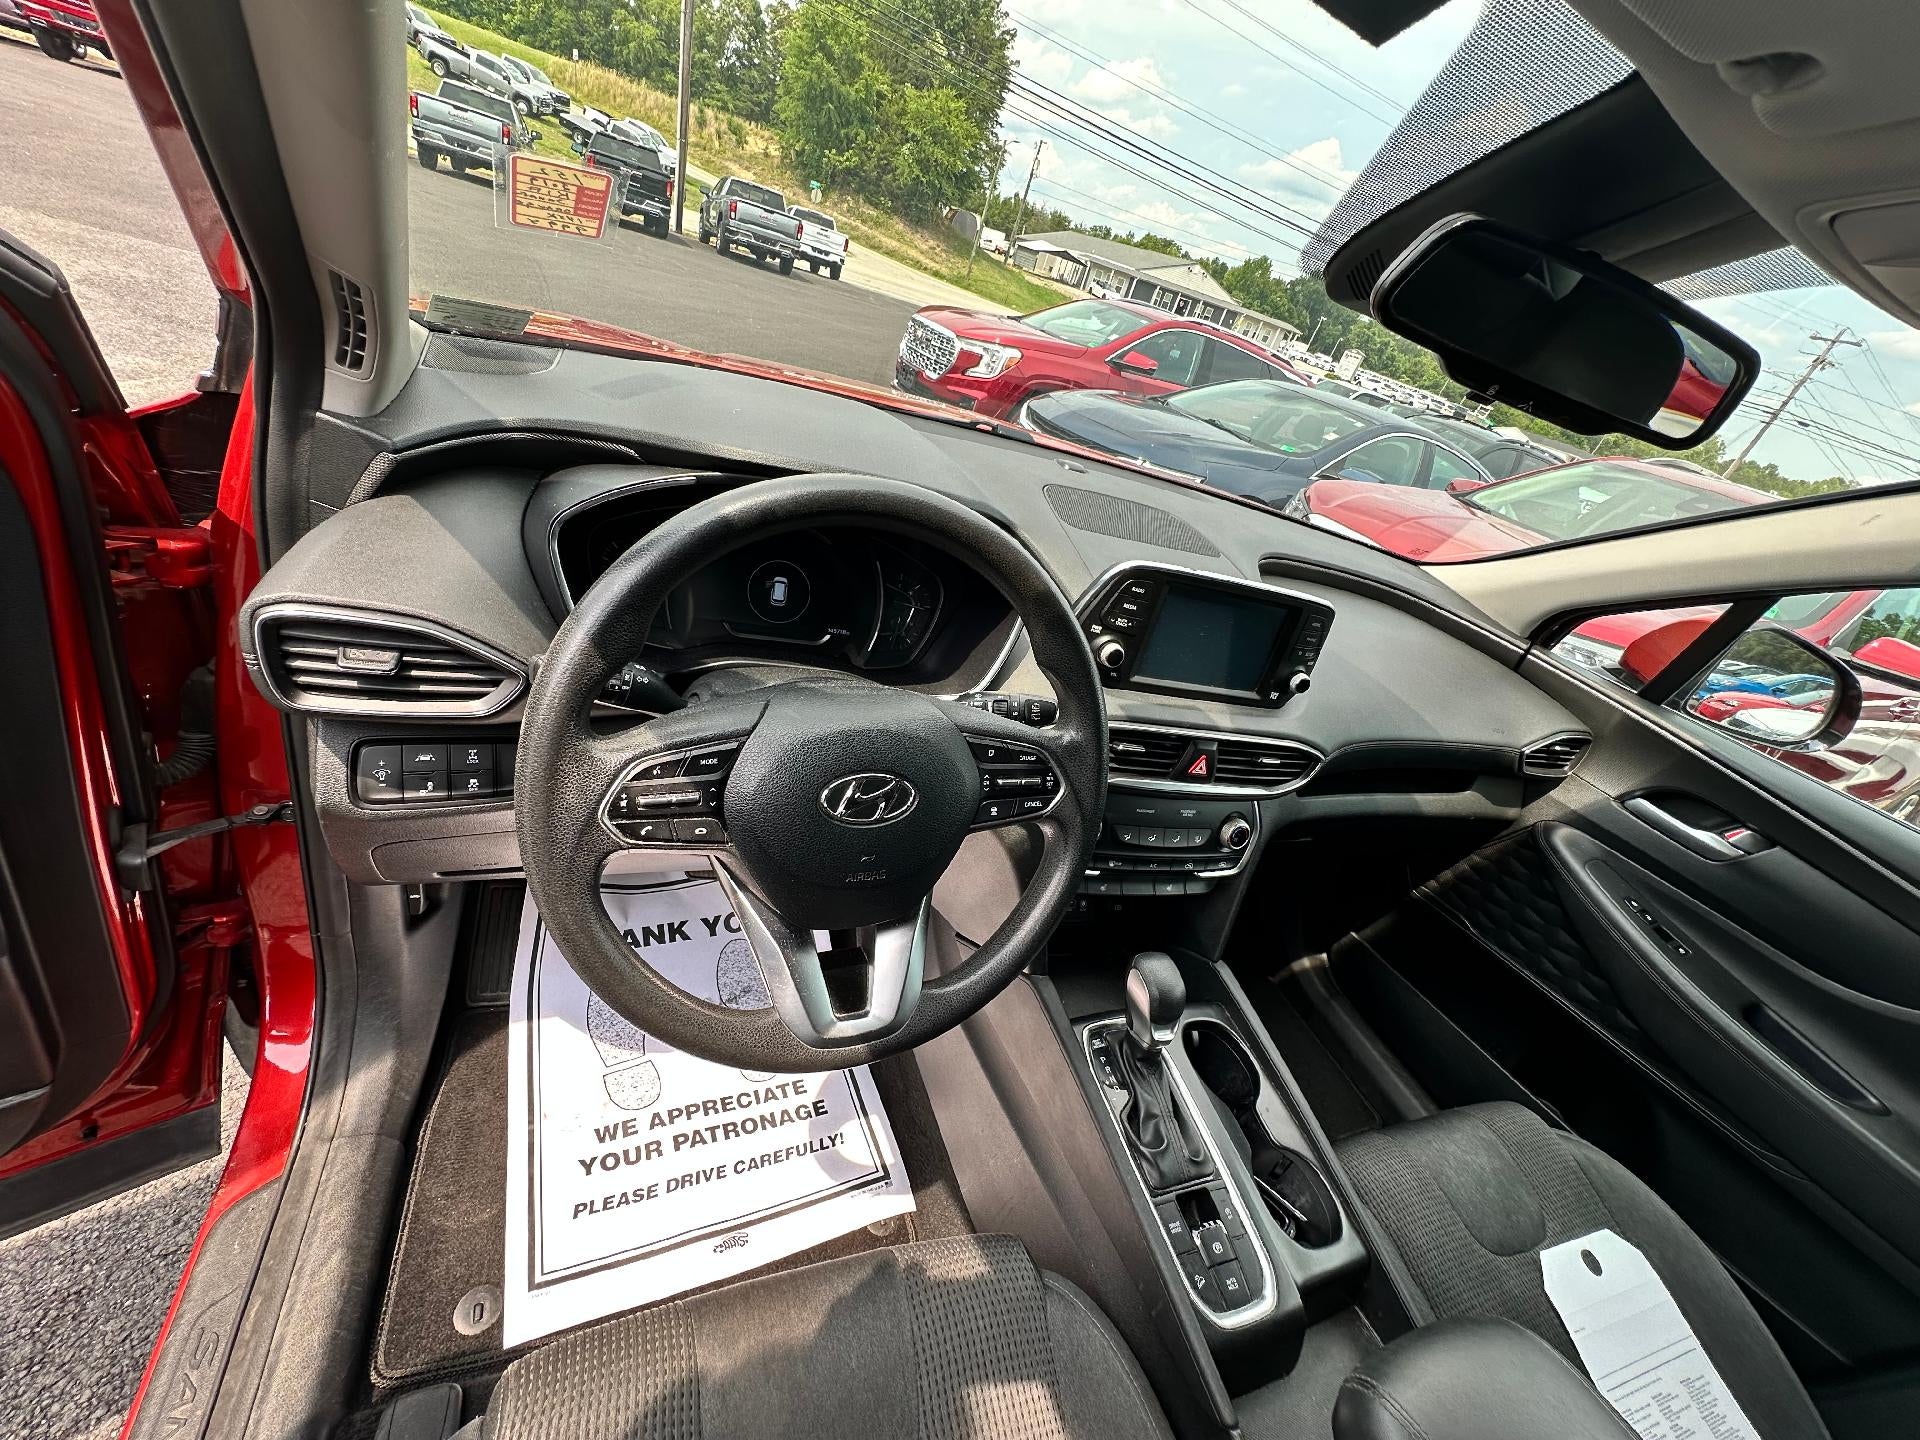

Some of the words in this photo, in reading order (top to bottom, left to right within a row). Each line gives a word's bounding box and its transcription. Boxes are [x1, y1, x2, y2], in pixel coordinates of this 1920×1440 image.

[845, 870, 887, 883] AIRBAG
[622, 919, 693, 949] ANK
[700, 911, 743, 938] YO
[578, 1139, 664, 1177] YOUR
[673, 1099, 829, 1152] PATRONAGE
[594, 1117, 640, 1145] WE
[649, 1079, 808, 1131] APPRECIATE
[572, 1183, 659, 1220] PLEASE
[665, 1164, 728, 1195] DRIVE
[733, 1132, 846, 1175] CAREFULLY!
